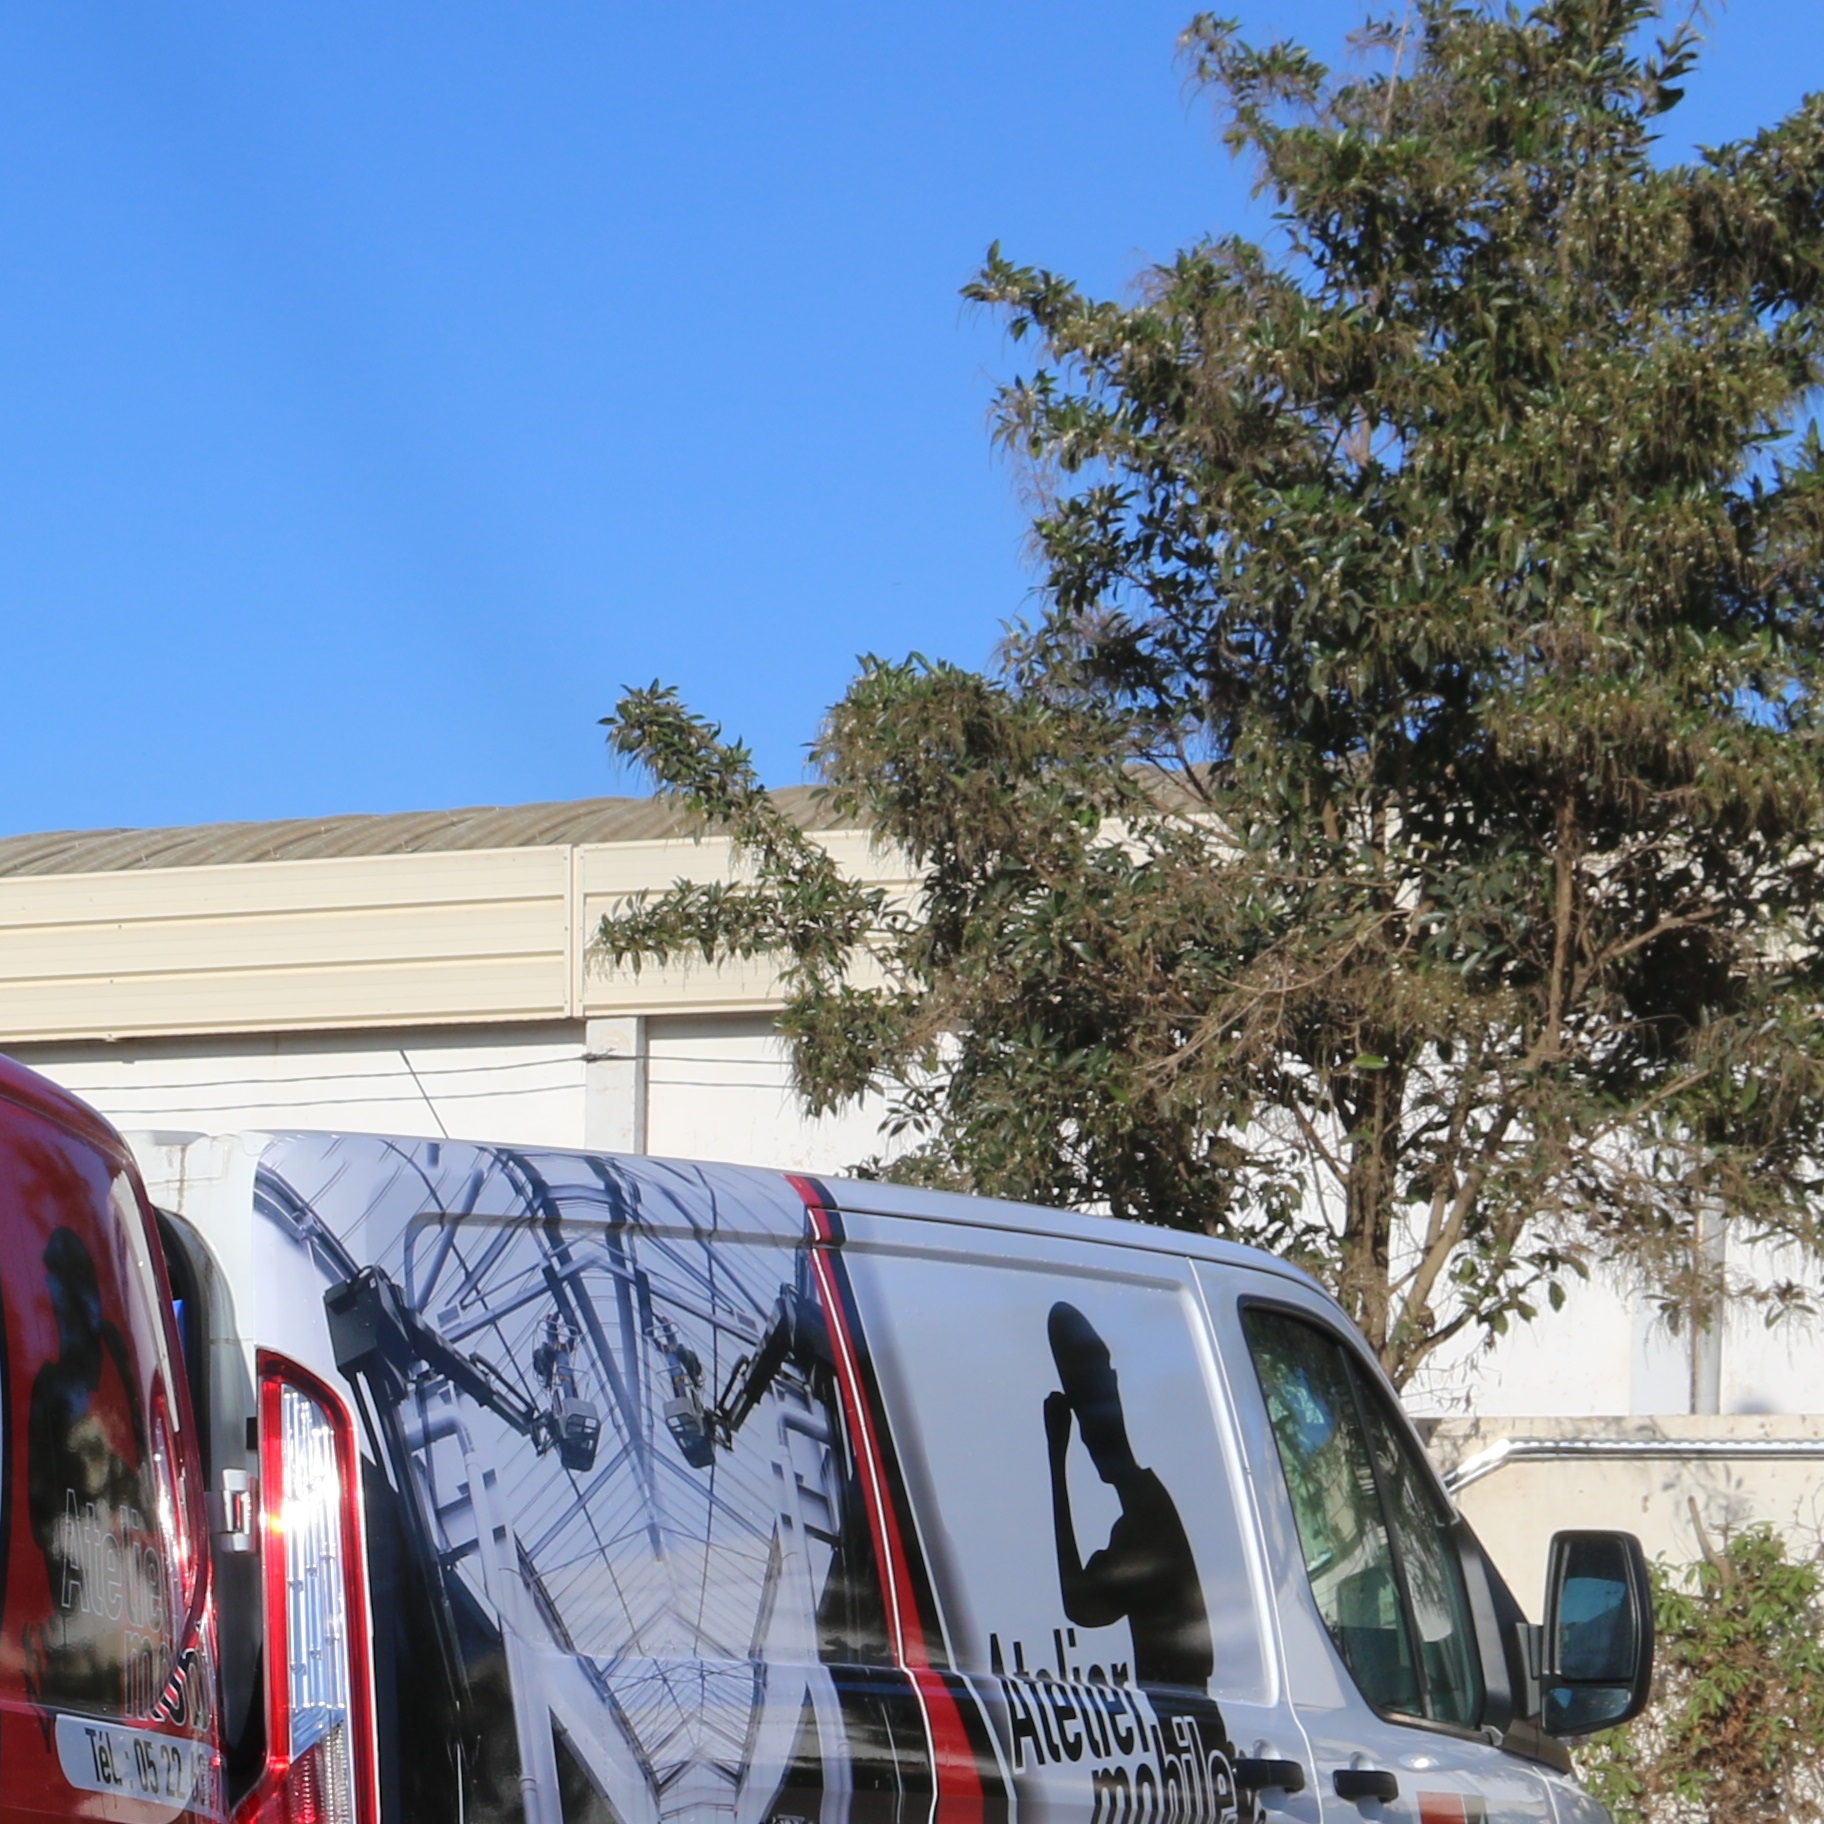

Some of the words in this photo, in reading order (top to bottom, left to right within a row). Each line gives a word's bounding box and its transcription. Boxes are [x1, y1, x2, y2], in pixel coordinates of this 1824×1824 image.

[989, 1627, 1150, 1774] Atelier
[133, 1738, 159, 1794] 05
[160, 1744, 186, 1800] 22
